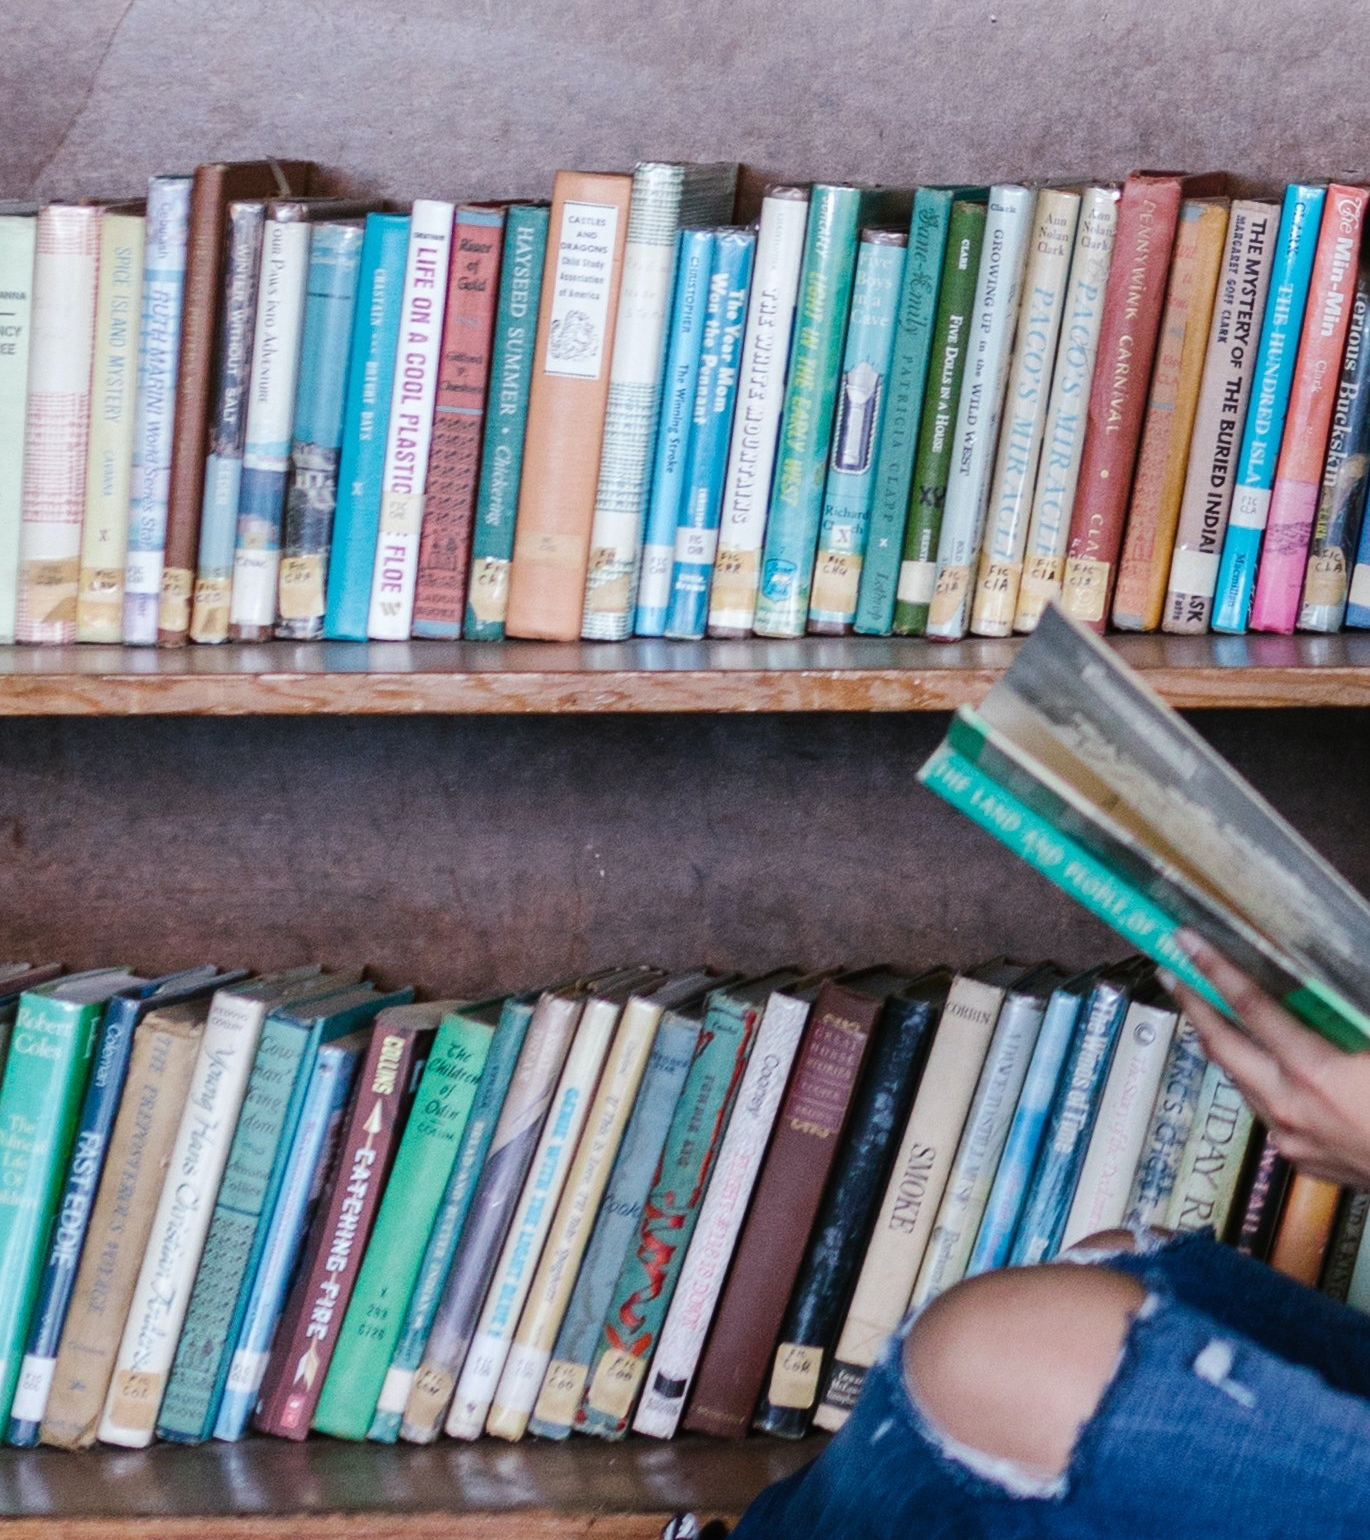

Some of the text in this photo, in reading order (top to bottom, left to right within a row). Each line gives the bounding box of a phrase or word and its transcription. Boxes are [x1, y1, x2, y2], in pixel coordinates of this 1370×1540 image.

[500, 226, 535, 415] HAYSEED SUMMER
[1210, 221, 1268, 488] THE MYSTERY OF THE BURIED
[1320, 237, 1354, 337] Min-Min
[391, 247, 437, 494] LIFE ON A COOL PLASTIC
[380, 545, 405, 593] FLOE
[372, 1035, 404, 1095] COLLINS
[49, 1130, 101, 1269] FAST EDDIE
[306, 1147, 376, 1341] CATCHING FIRE
[888, 1141, 936, 1234] SMOKE
